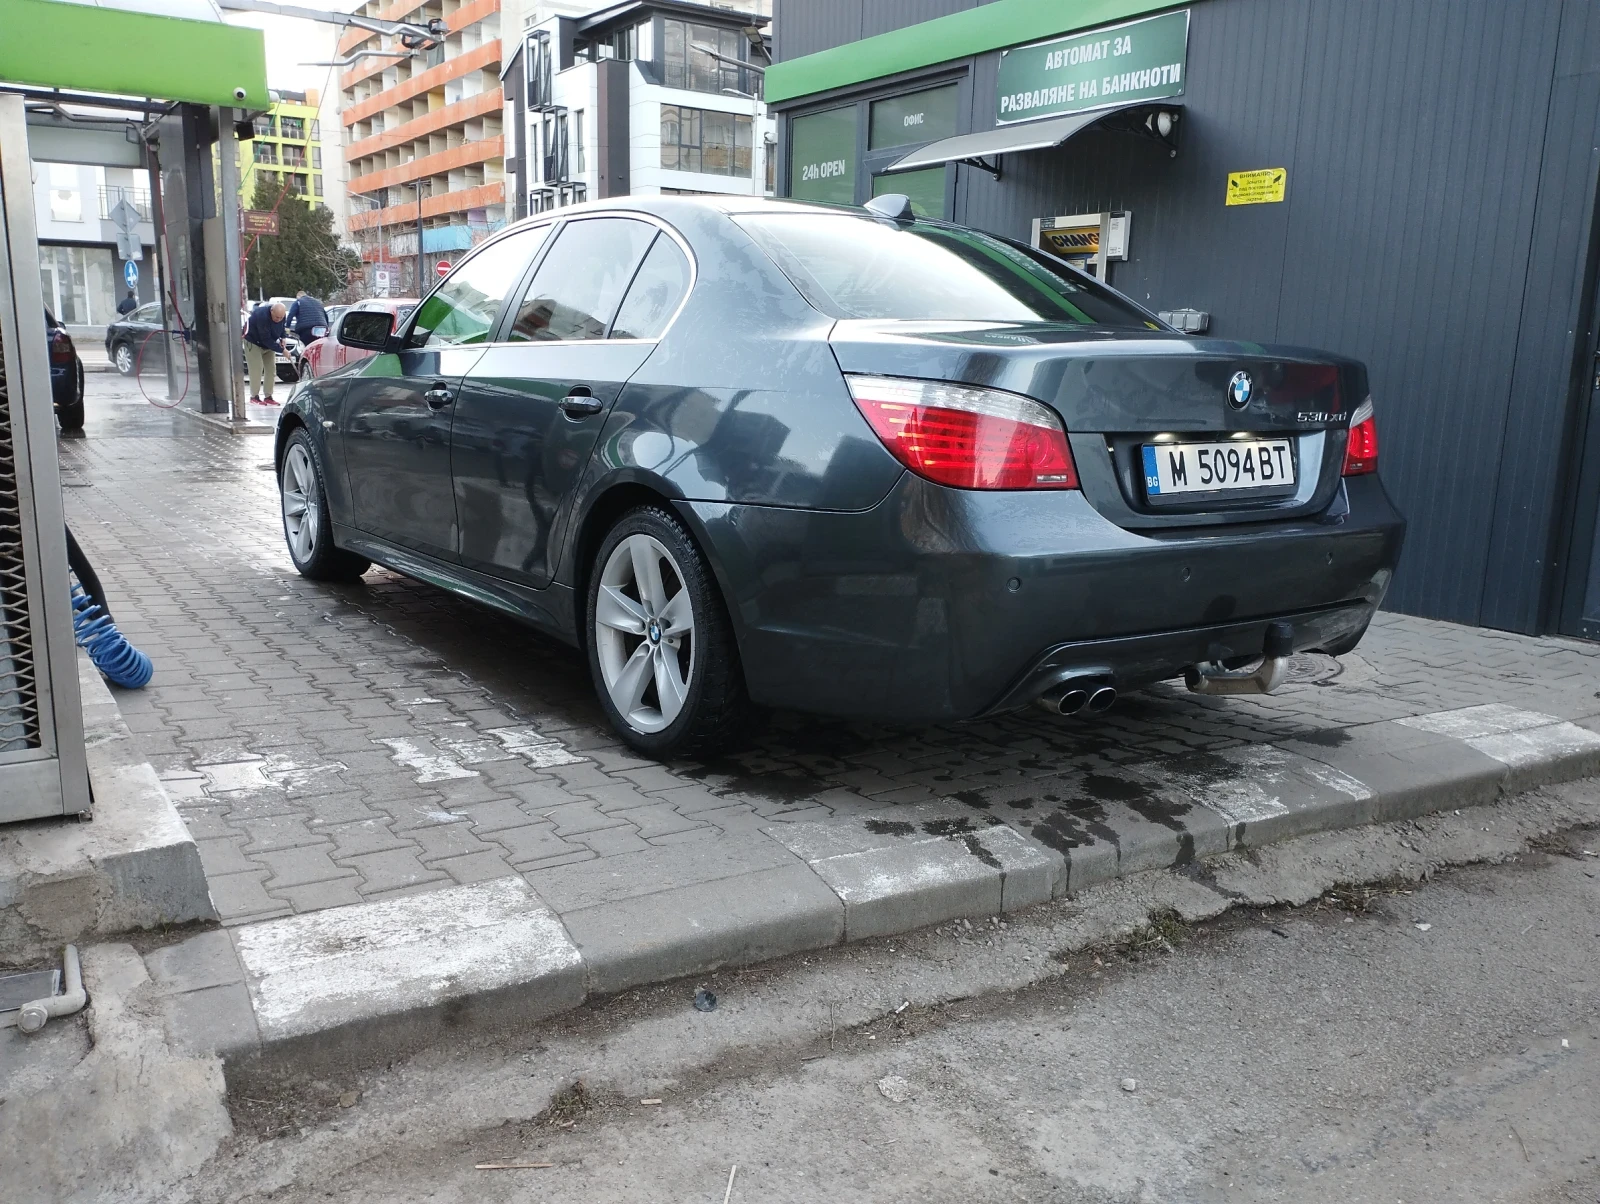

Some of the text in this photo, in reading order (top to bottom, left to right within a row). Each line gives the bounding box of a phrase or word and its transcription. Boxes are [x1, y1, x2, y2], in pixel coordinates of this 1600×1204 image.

[1044, 35, 1132, 71] АВТОМАТ ЗА
[1000, 63, 1181, 113] РАЗВАЛЯНЕ НА БАНКНОТИ
[903, 112, 924, 127] ОФИС
[802, 159, 846, 181] 24h OPEN
[1168, 445, 1286, 487] M 5094BT
[1147, 475, 1159, 488] BG
